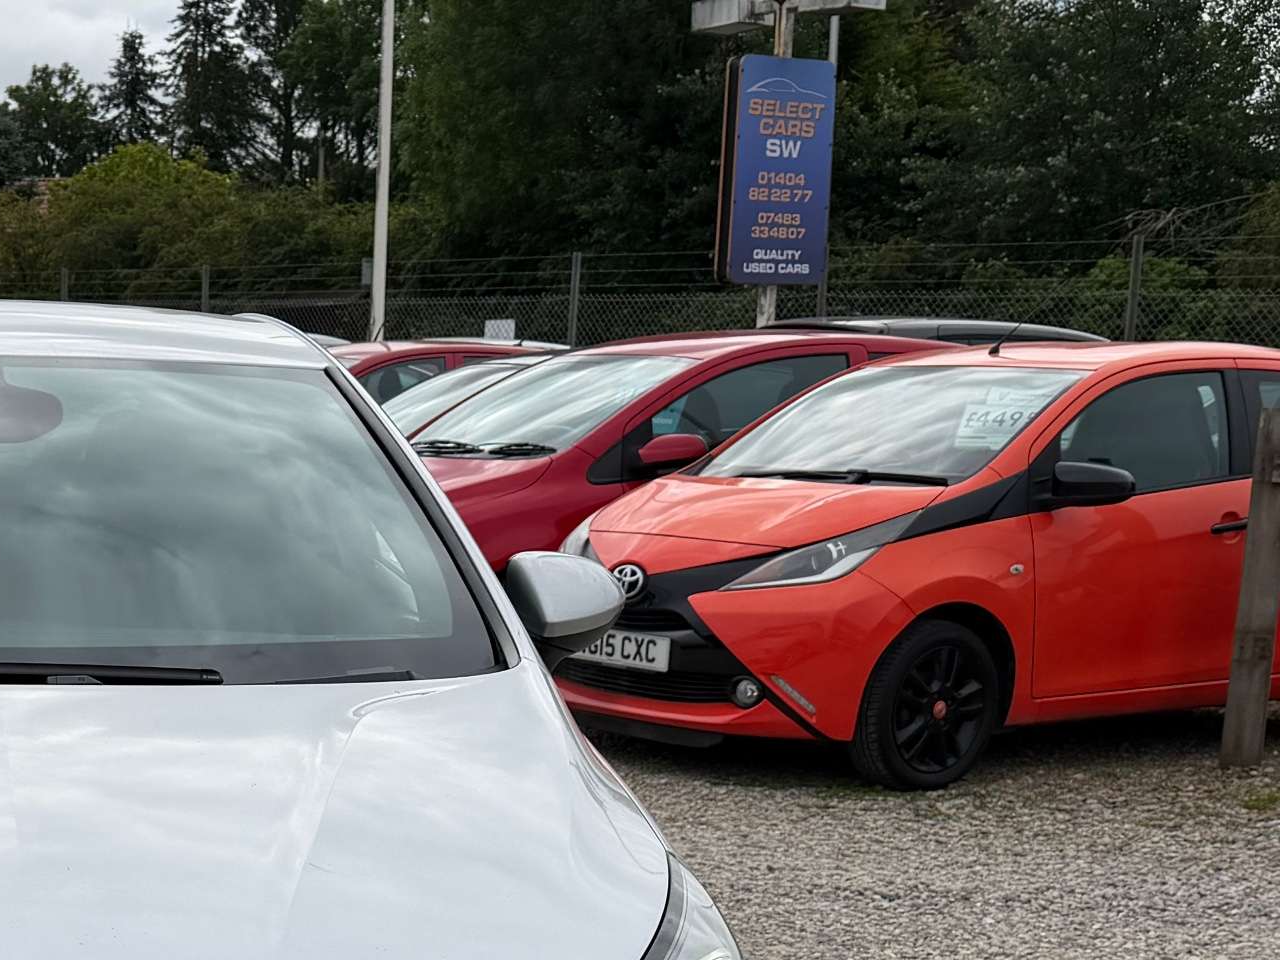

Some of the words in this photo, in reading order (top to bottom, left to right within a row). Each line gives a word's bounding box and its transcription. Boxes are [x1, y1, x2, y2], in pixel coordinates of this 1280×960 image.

[748, 98, 825, 120] SELECT
[759, 117, 816, 138] CARS
[765, 138, 802, 159] SW
[758, 171, 806, 186] 01404
[758, 212, 801, 226] 07483
[751, 226, 806, 239] 334807
[753, 248, 802, 261] QUALITY
[743, 262, 776, 273] USED
[777, 263, 810, 275] CARS
[620, 634, 658, 664] CXC
